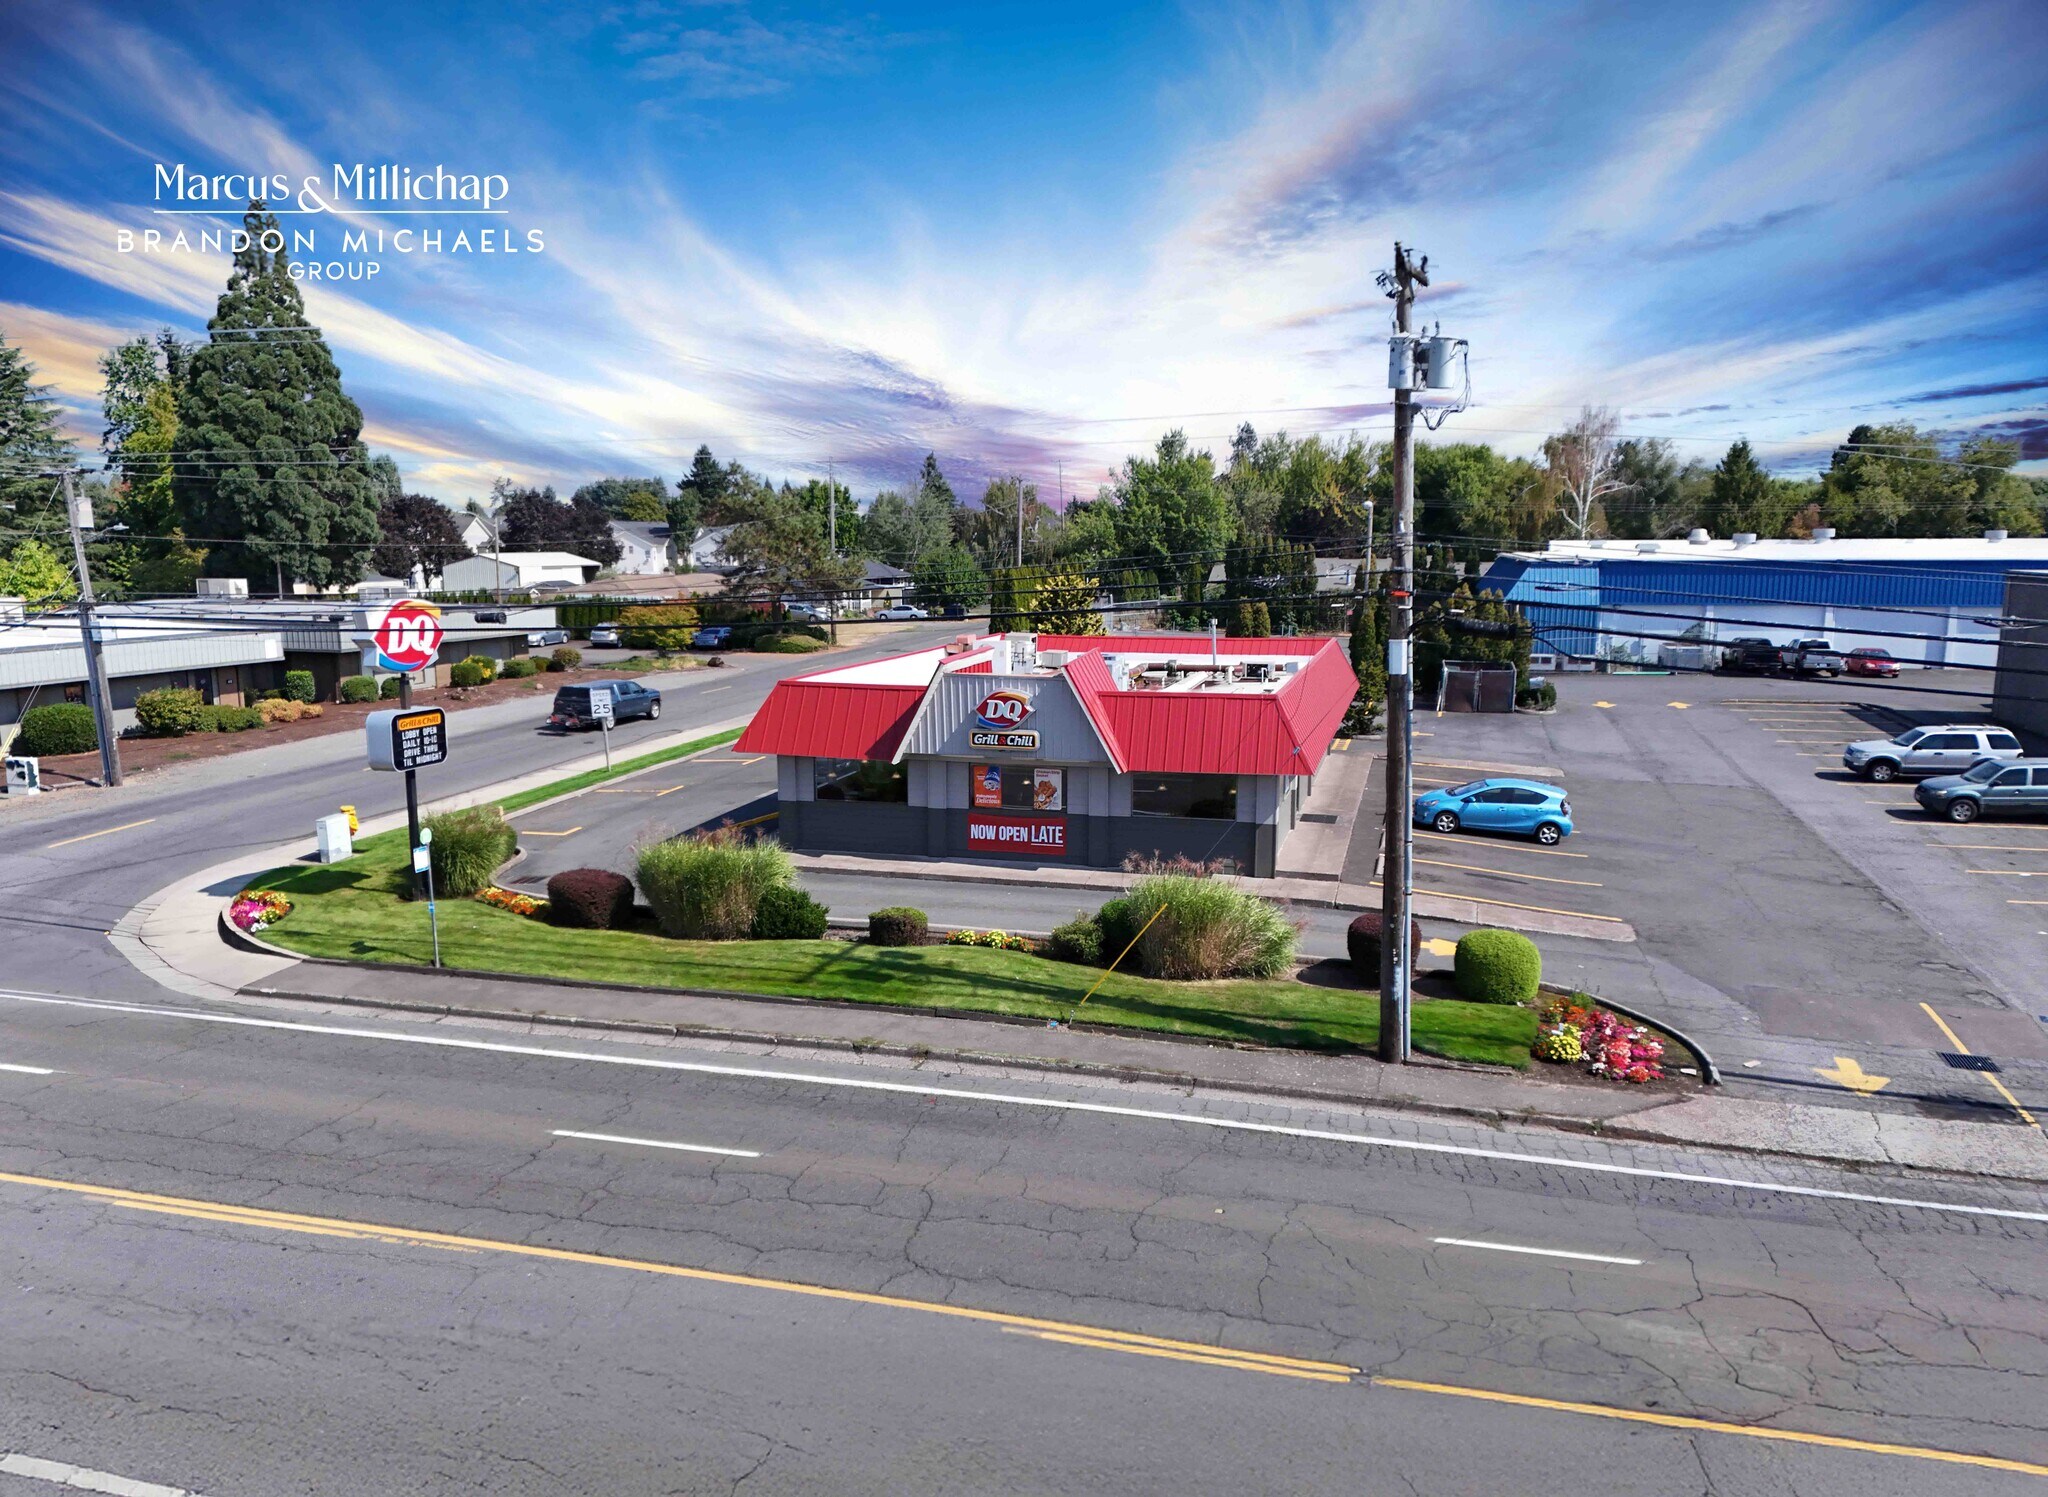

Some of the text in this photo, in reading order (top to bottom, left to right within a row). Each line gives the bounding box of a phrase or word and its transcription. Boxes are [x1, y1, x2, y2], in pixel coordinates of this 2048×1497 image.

[387, 614, 435, 656] DQ
[593, 704, 611, 715] 25
[984, 699, 1022, 722] DQ
[401, 726, 438, 740] LOBBY OPEN
[402, 738, 421, 749] DAILY
[403, 744, 438, 758] DRIVE THRU
[403, 752, 442, 767] TIL MIDNIGHT
[970, 824, 1064, 844] NOW OPEN LATE
